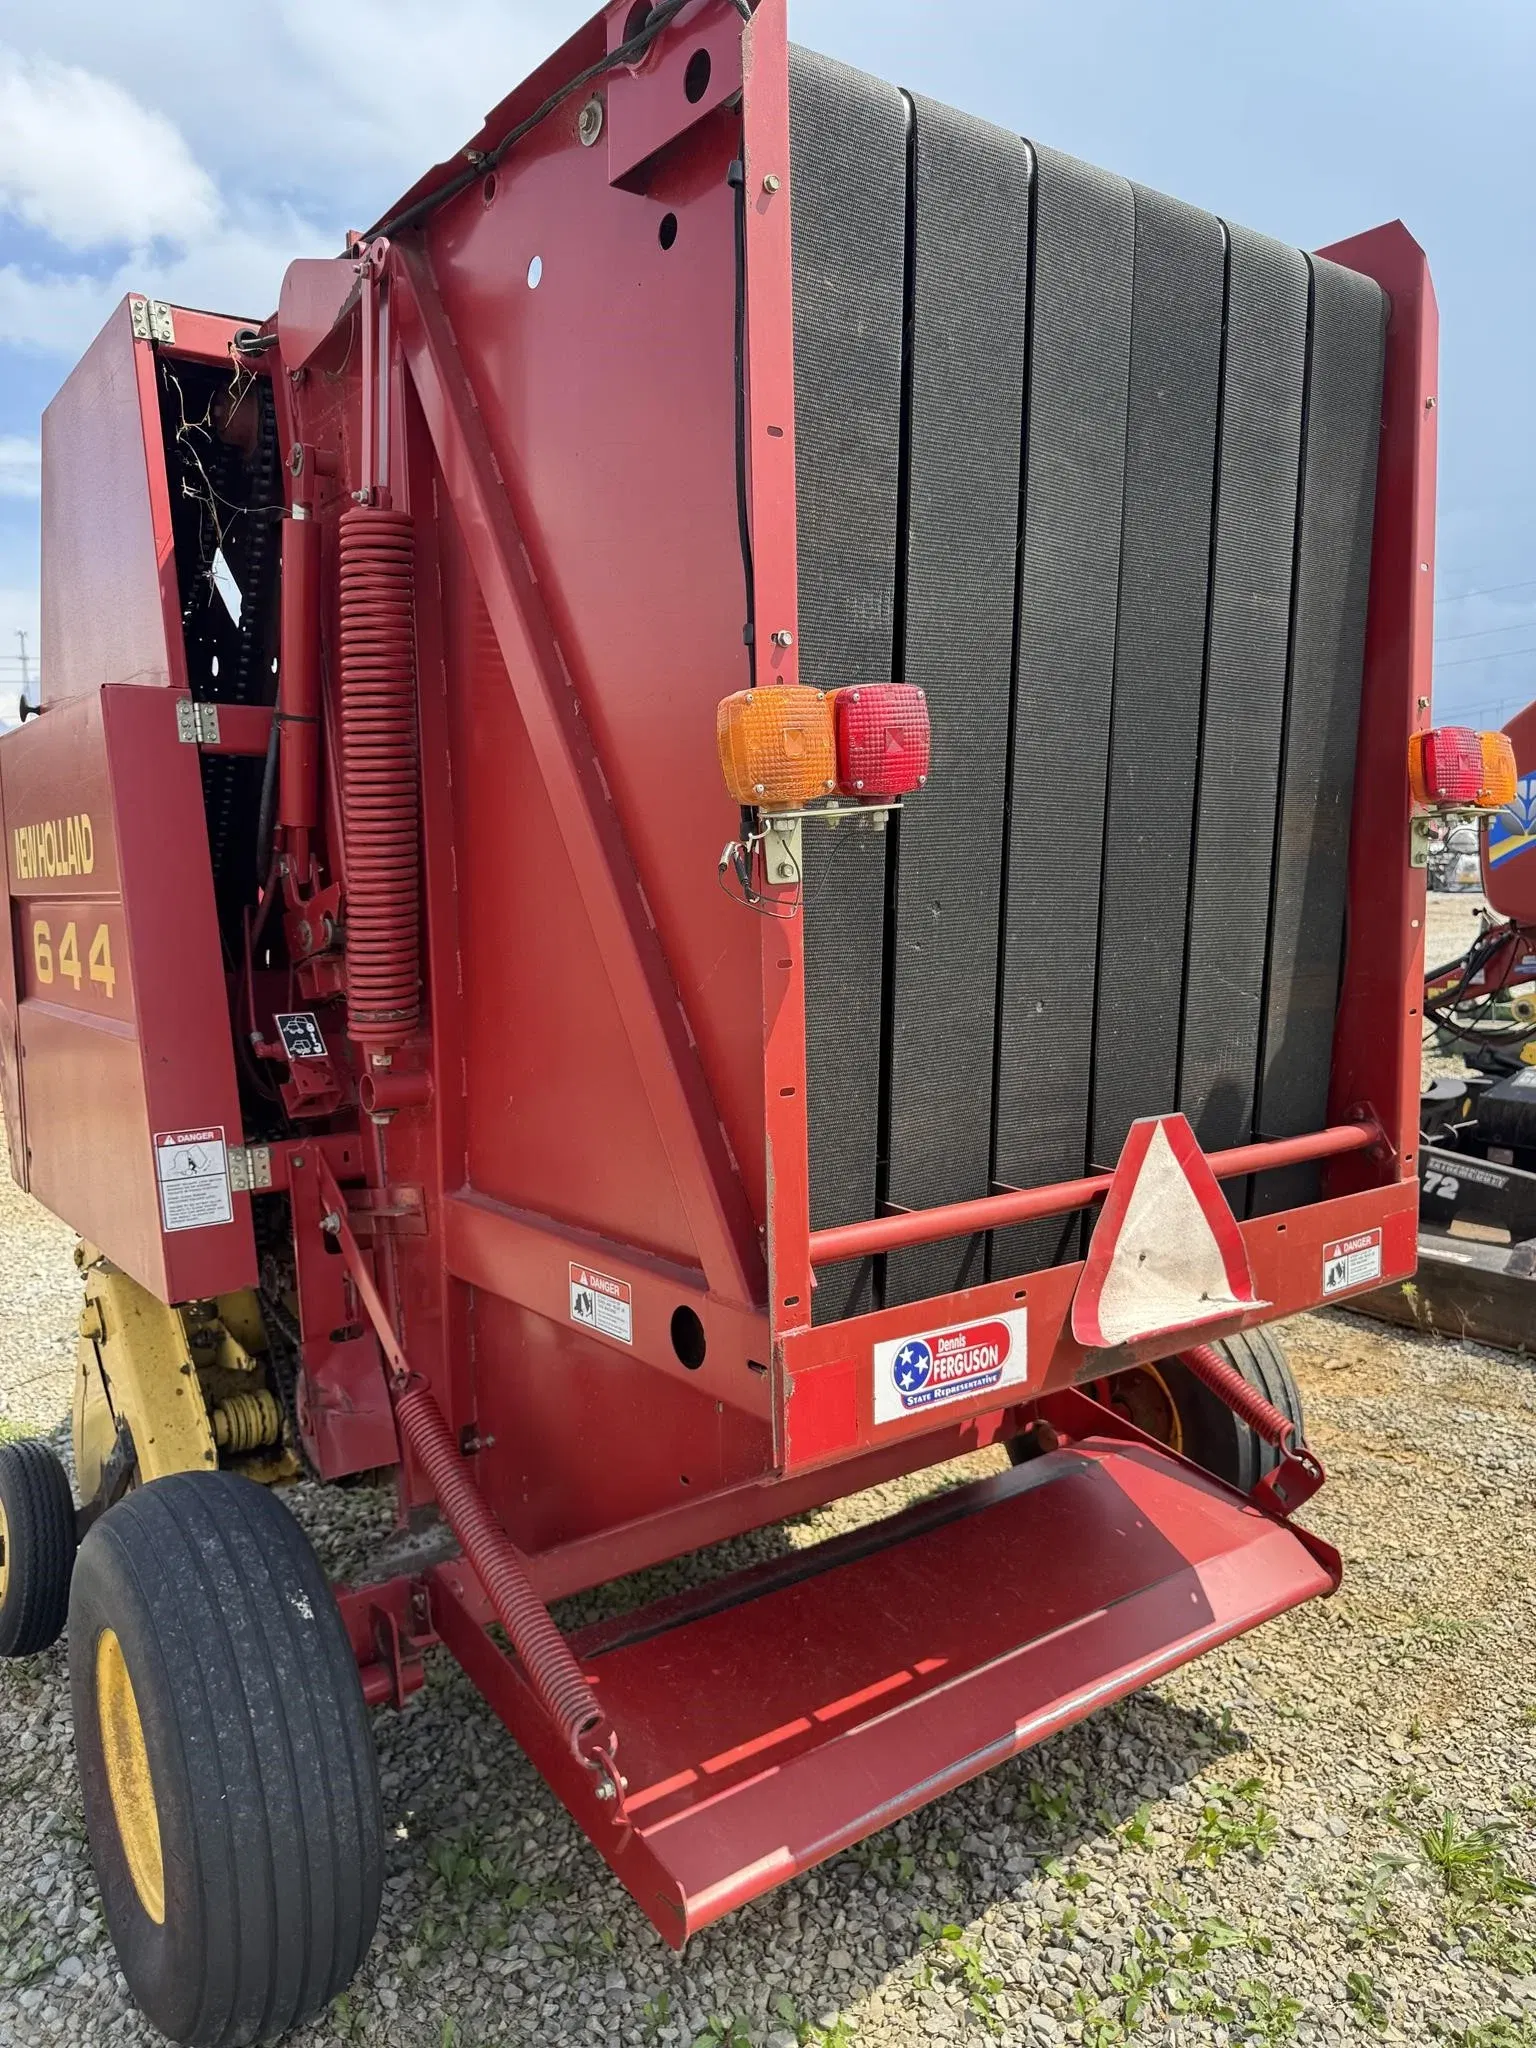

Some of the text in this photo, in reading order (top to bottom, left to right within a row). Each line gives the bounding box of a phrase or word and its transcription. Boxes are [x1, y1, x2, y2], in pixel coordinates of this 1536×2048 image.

[33, 919, 116, 999] 644
[177, 1131, 214, 1143] DANGER
[1423, 1171, 1459, 1200] 72
[1343, 1235, 1372, 1252] DANGER
[589, 1275, 620, 1296] DANGER
[938, 1333, 966, 1353] Dennis
[933, 1344, 999, 1383] FERGUSON
